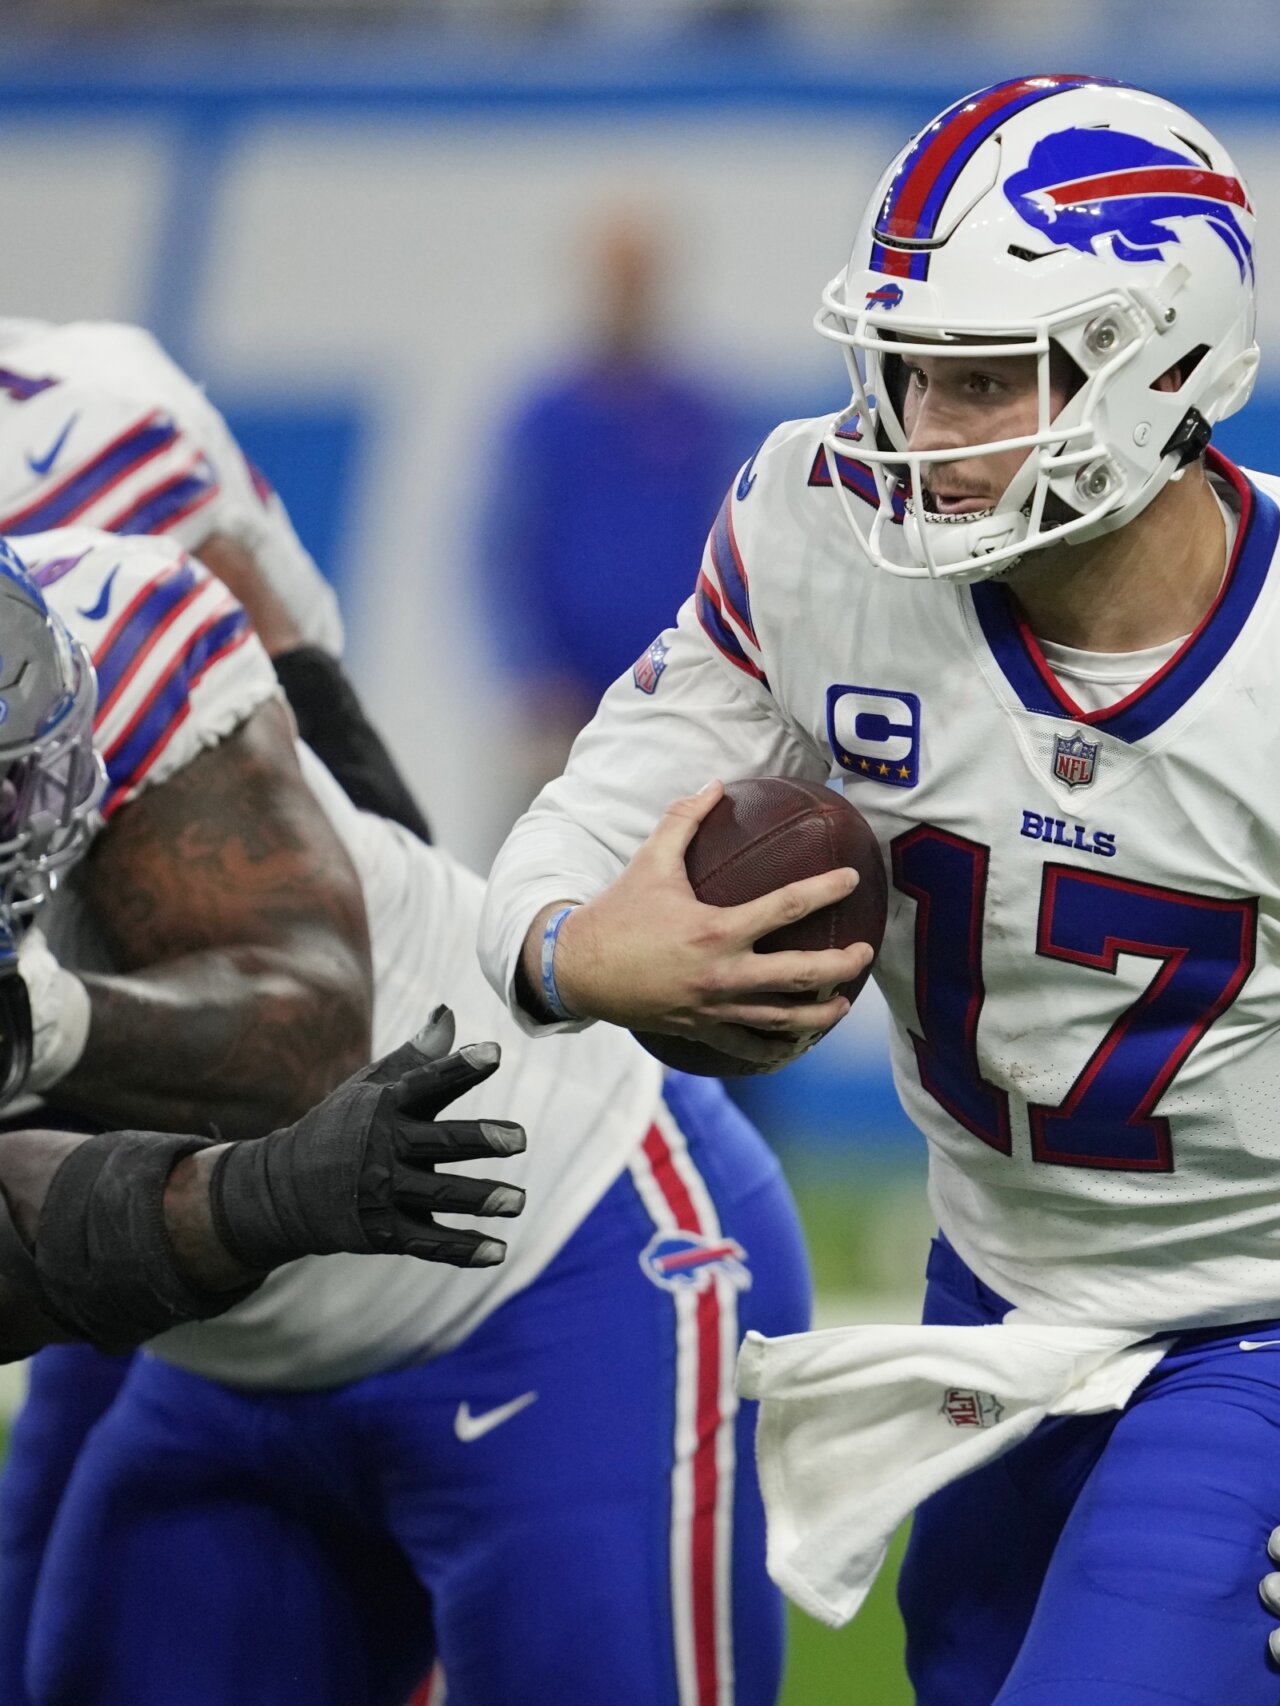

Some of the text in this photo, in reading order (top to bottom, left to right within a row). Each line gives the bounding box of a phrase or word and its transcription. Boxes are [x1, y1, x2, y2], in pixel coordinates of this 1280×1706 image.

[834, 692, 913, 762] C
[1058, 755, 1089, 783] NFL
[1020, 809, 1117, 858] BILLS
[892, 822, 1259, 1172] 17
